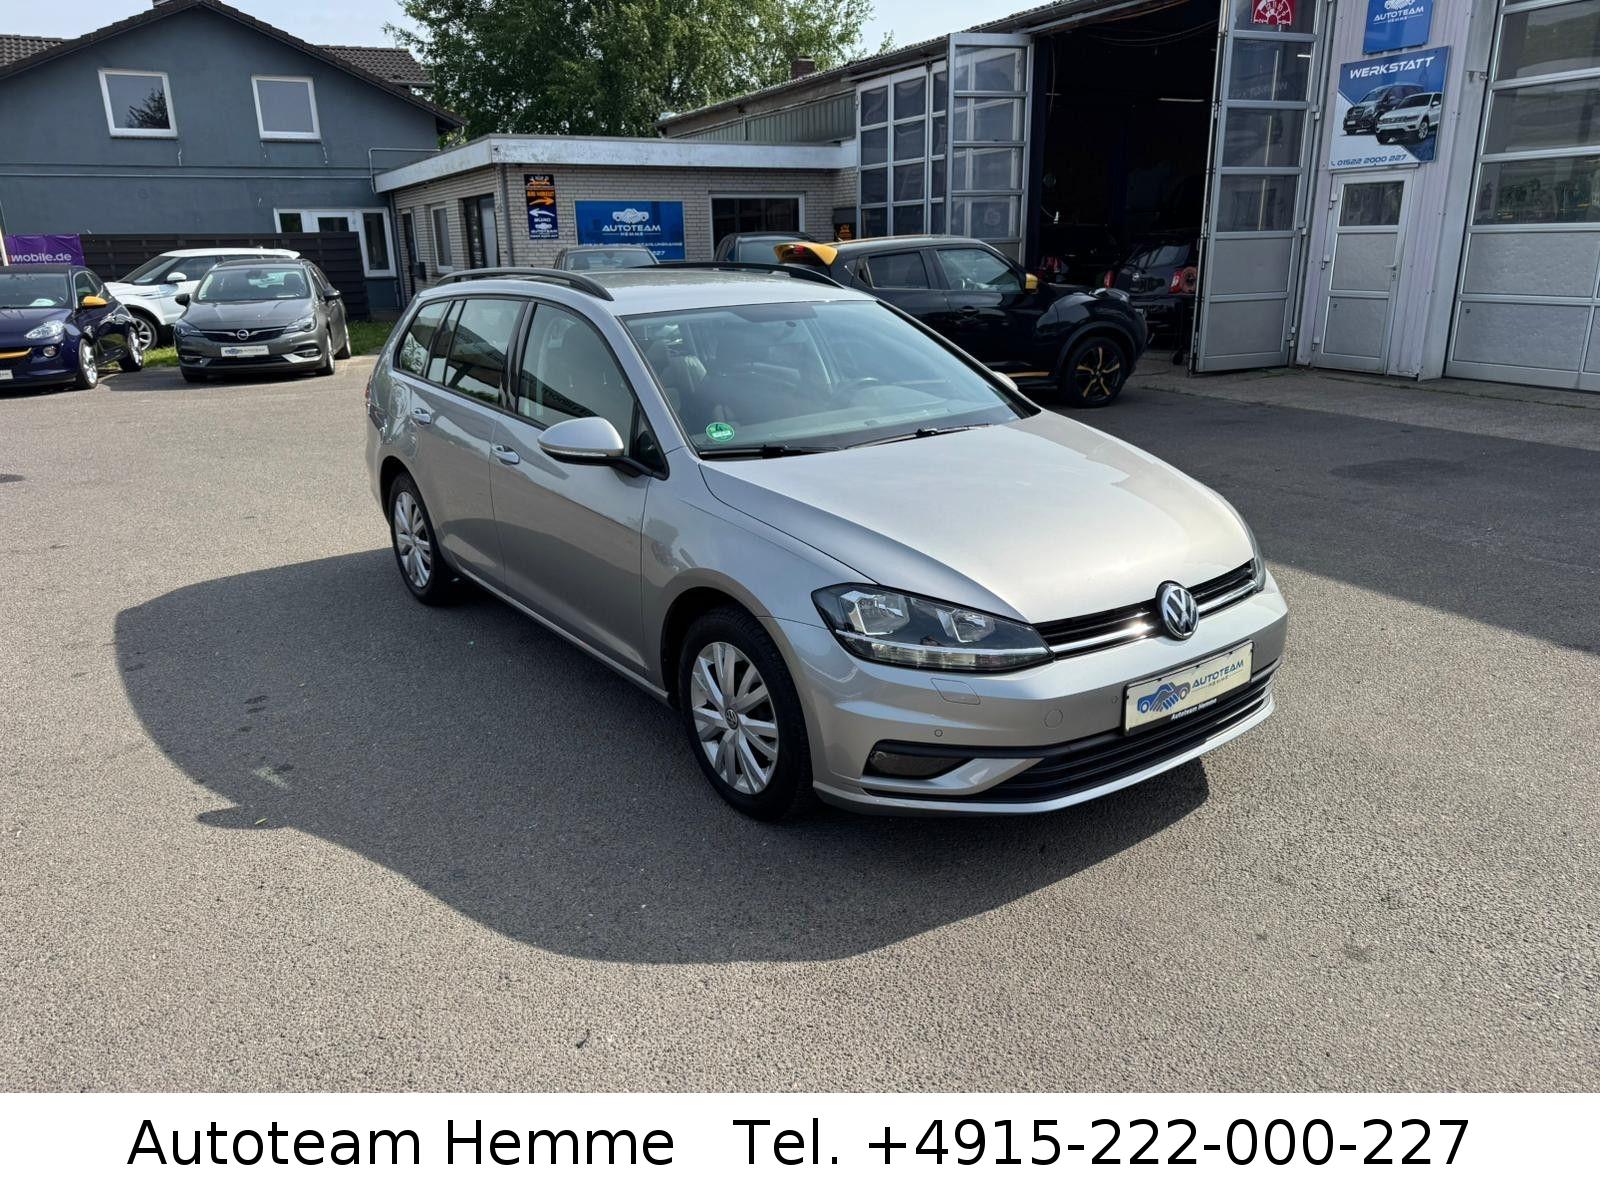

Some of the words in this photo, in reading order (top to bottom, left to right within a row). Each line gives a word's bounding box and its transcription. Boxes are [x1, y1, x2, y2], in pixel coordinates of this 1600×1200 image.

[1373, 6, 1424, 21] AUTOTEAM
[1350, 56, 1436, 79] WERKSTATT
[1337, 157, 1362, 167] 01522
[1363, 155, 1387, 164] 2000
[1388, 153, 1407, 162] 227
[602, 224, 661, 232] AUTOTEAM
[11, 252, 72, 262] mobile.de
[1192, 660, 1244, 689] AUTOTEAM
